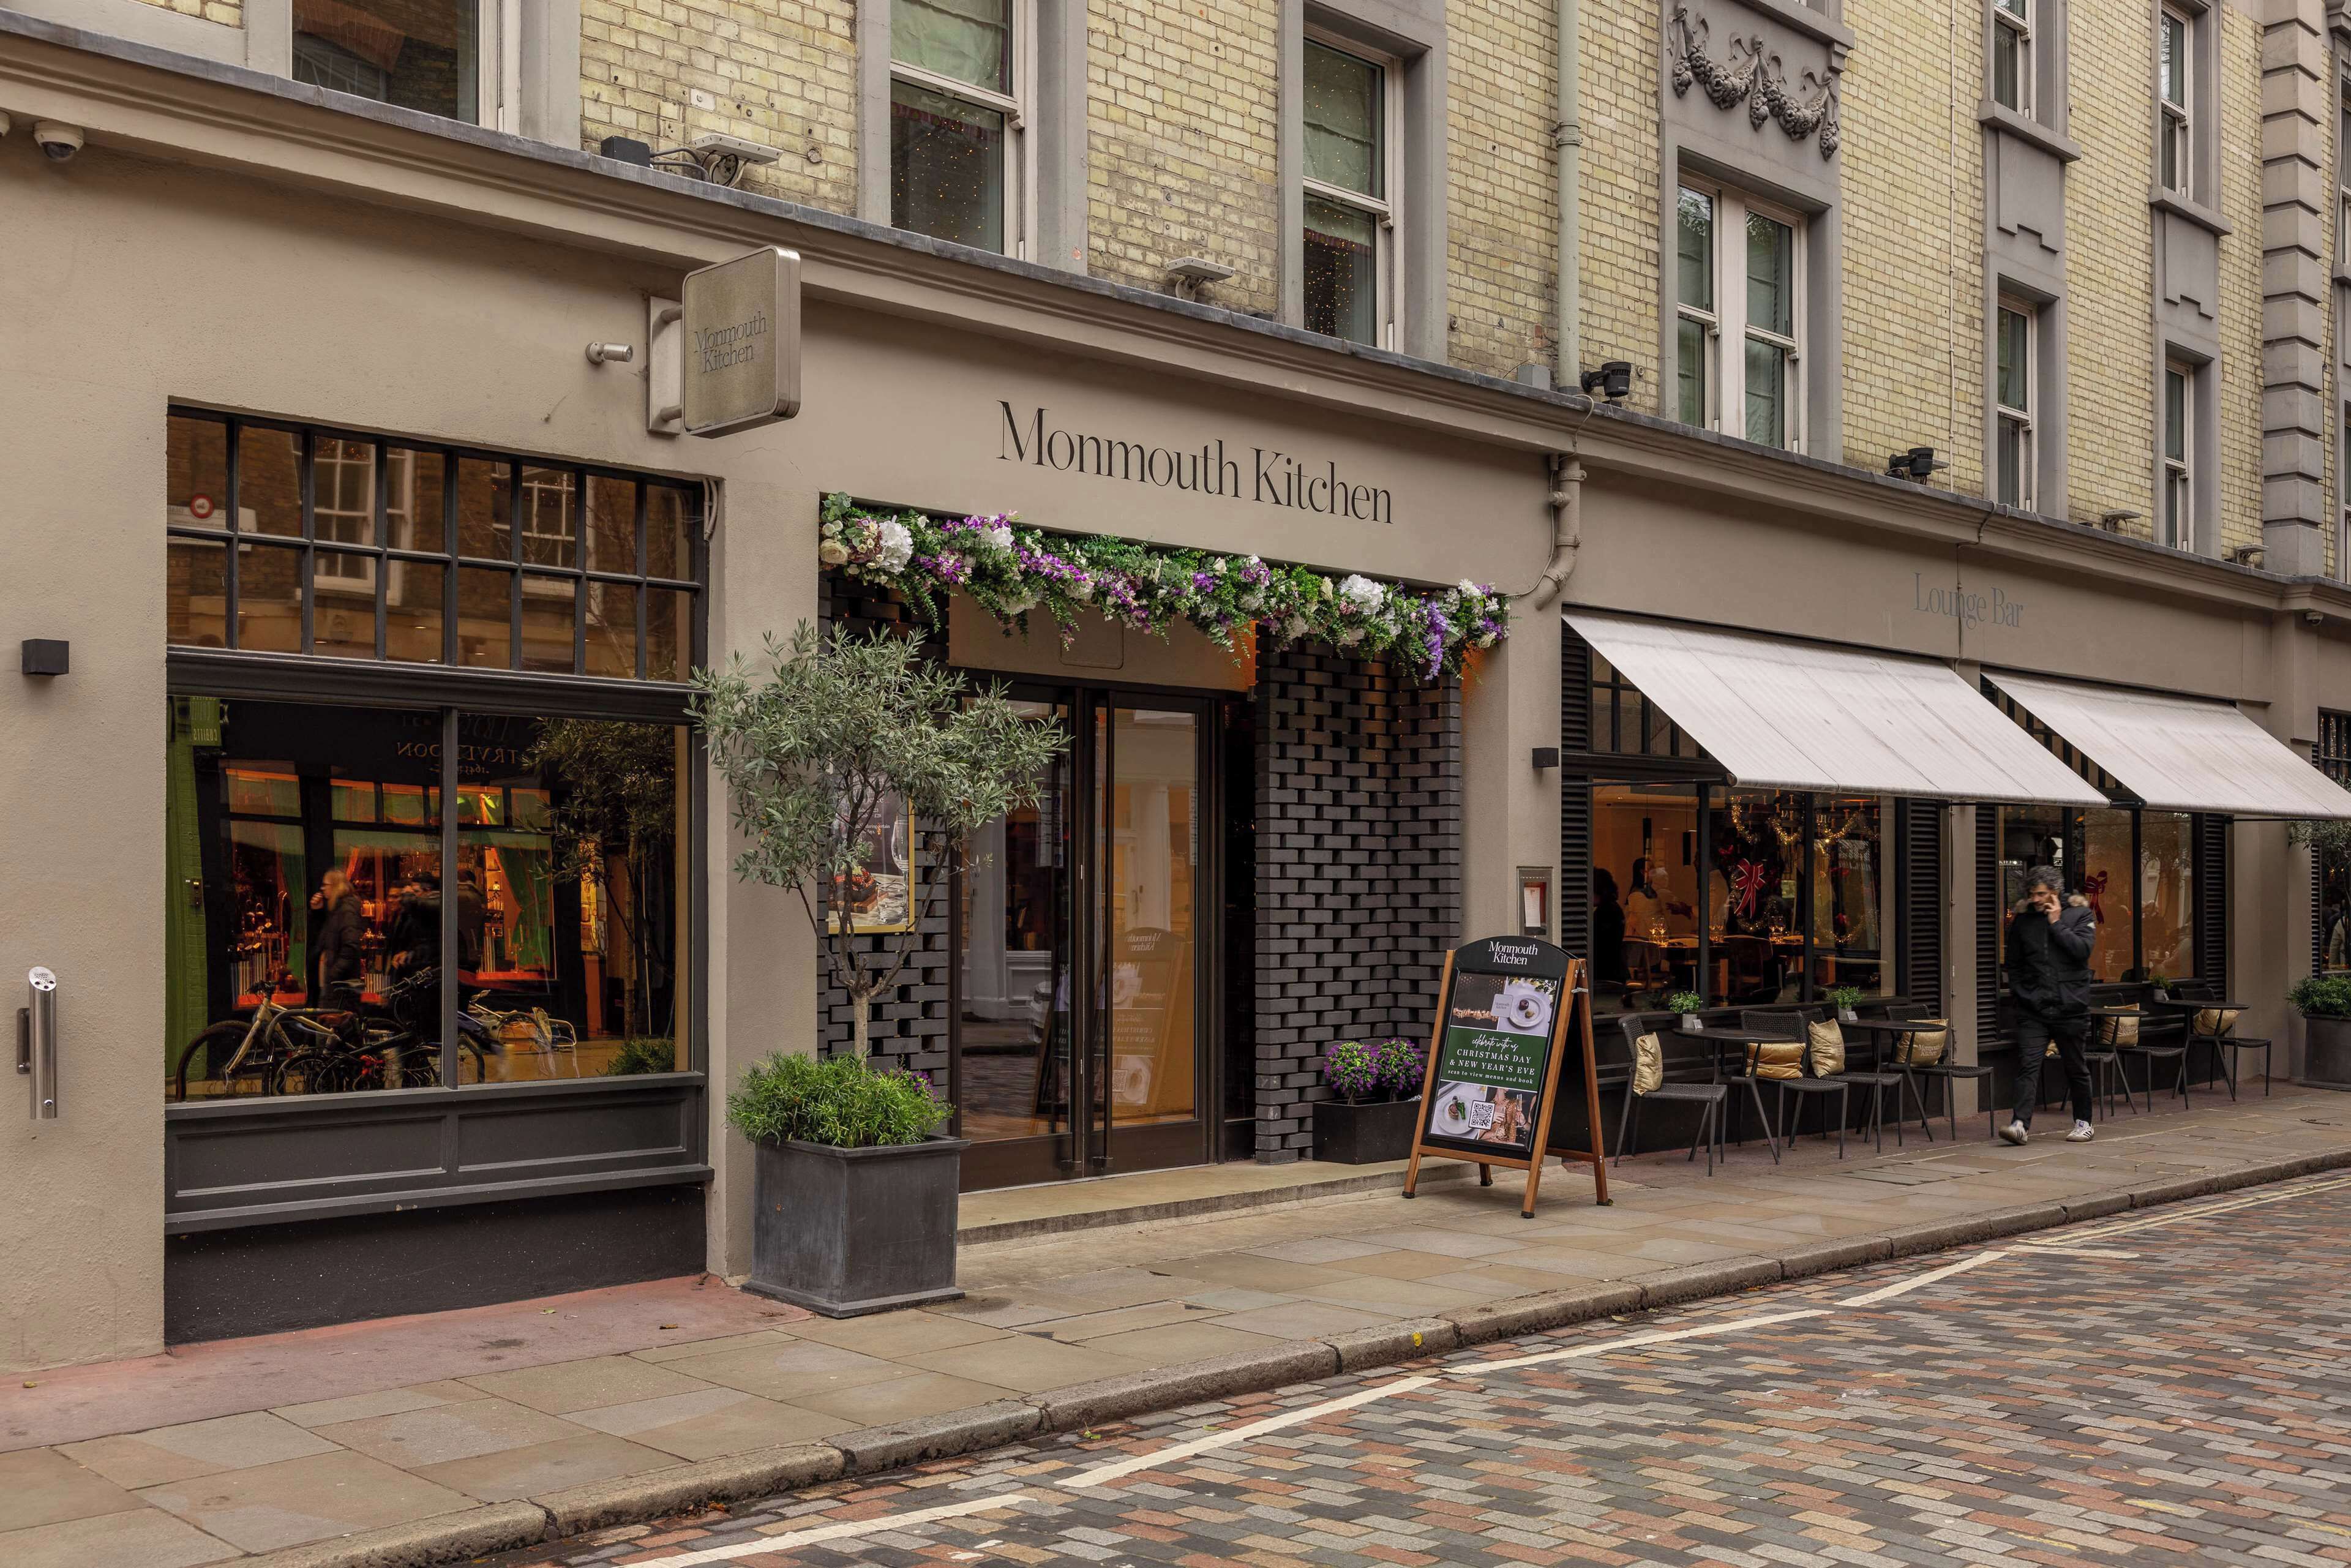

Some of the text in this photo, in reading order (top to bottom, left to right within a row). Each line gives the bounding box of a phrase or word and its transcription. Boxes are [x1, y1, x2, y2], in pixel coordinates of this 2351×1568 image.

[694, 311, 767, 353] Monmouth
[702, 343, 754, 374] Kitchen
[996, 399, 1393, 524] Monmouth Kitchen
[1913, 572, 2023, 630] Lounge Bar
[1488, 940, 1538, 955] Monmouth
[1492, 952, 1528, 965] Kitchen
[1472, 1034, 1499, 1051] celebrate
[1496, 1037, 1512, 1052] with
[1457, 1048, 1532, 1063] CHRISTMAS DAY
[1458, 1059, 1478, 1068] NEW
[1482, 1062, 1513, 1073] YEAR'S
[1517, 1067, 1535, 1075] EVE
